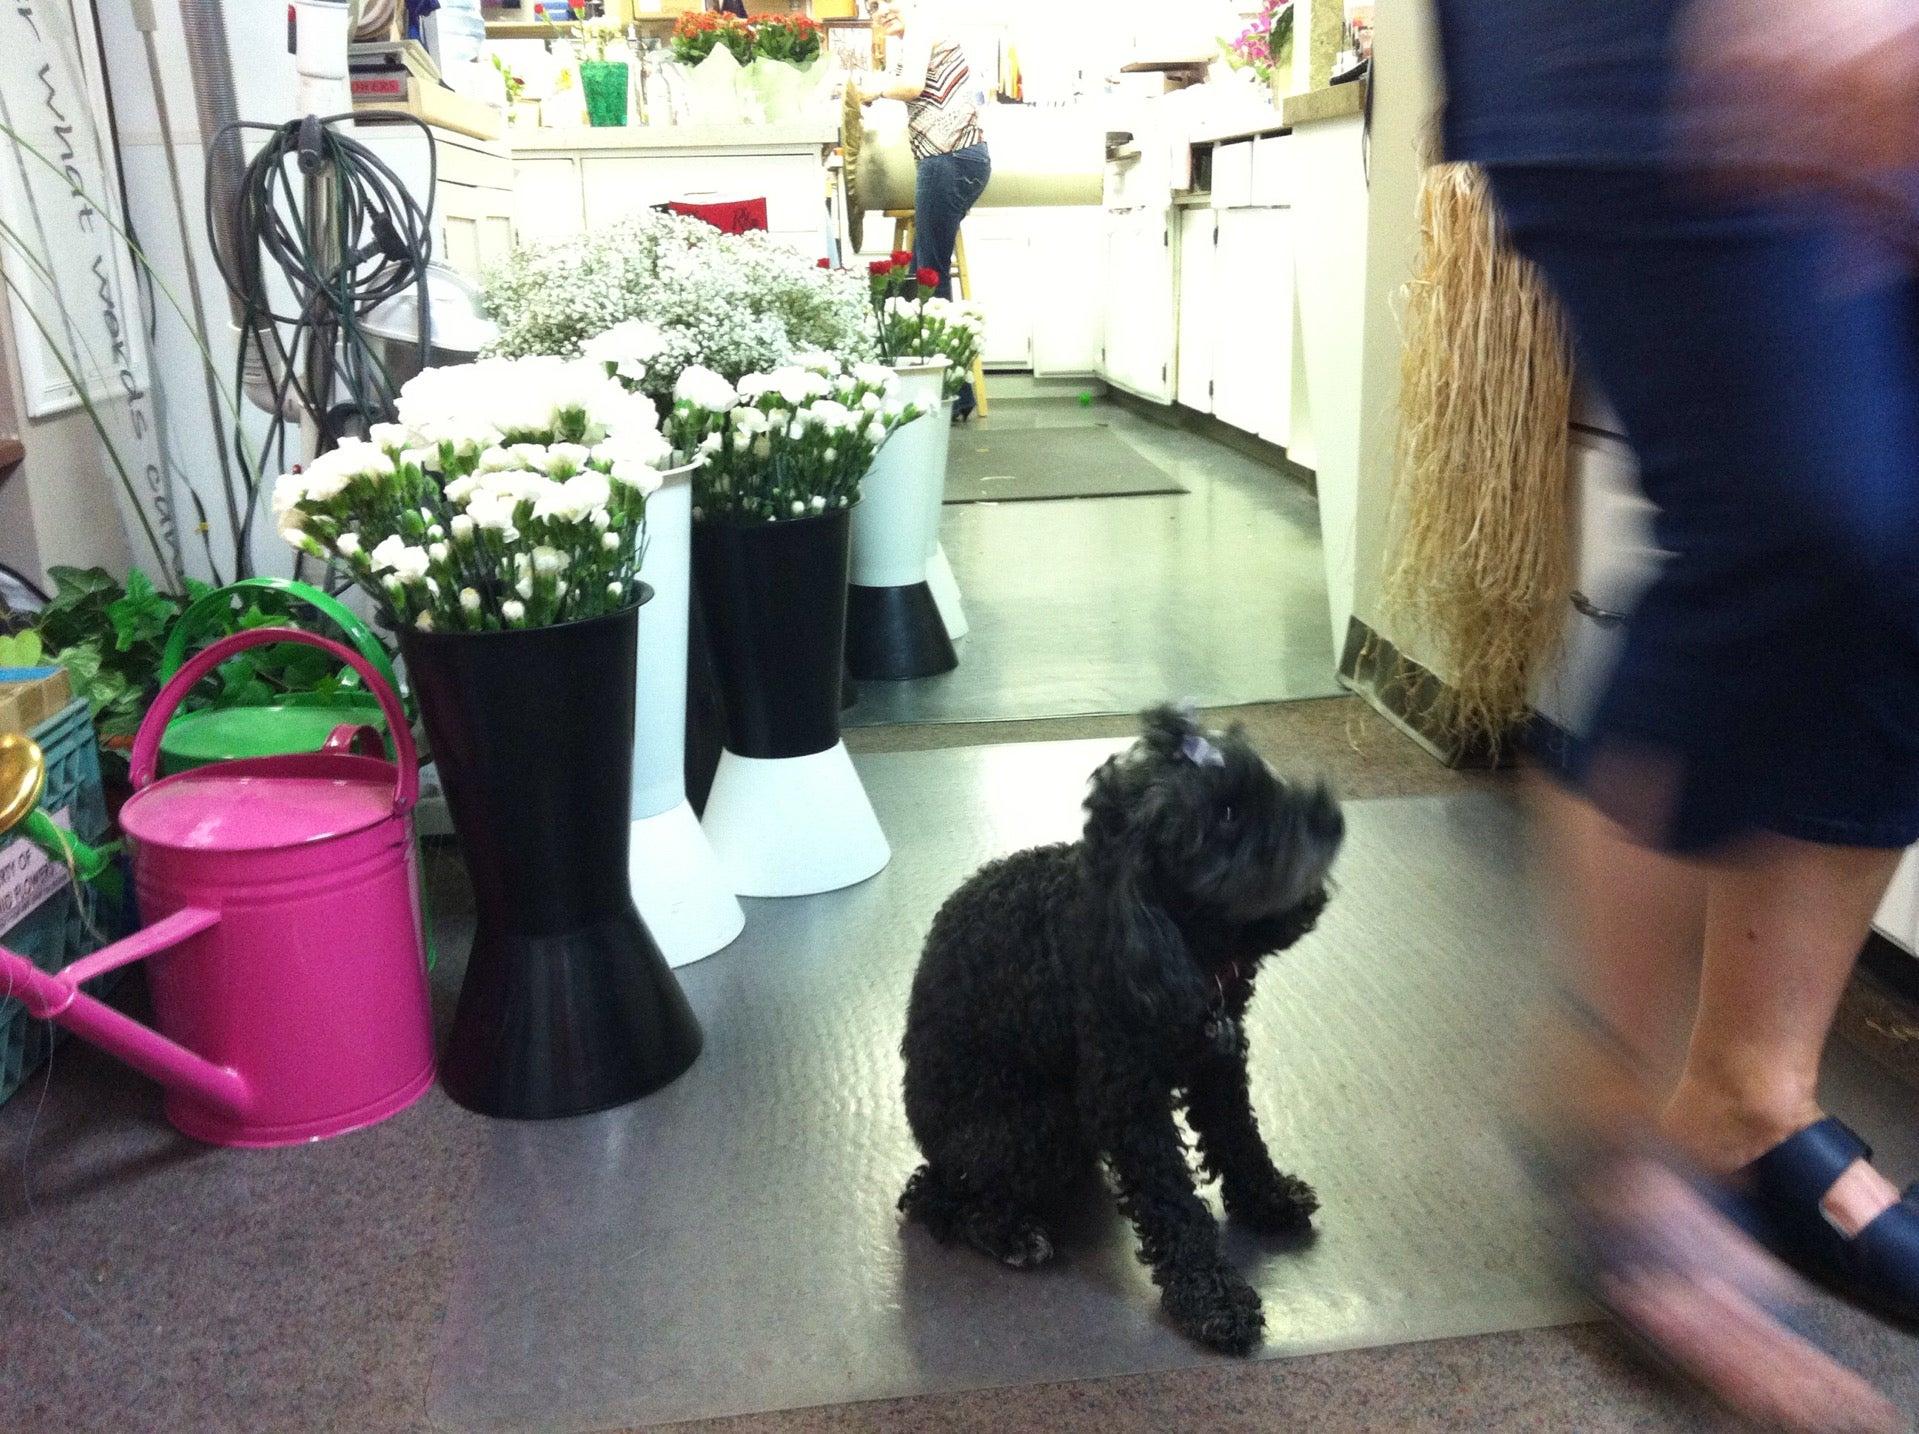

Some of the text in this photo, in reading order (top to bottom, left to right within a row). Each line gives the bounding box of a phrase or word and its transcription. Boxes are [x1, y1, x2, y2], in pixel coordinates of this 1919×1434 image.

[38, 63, 94, 234] what
[92, 255, 145, 441] words
[18, 849, 31, 871] OF
